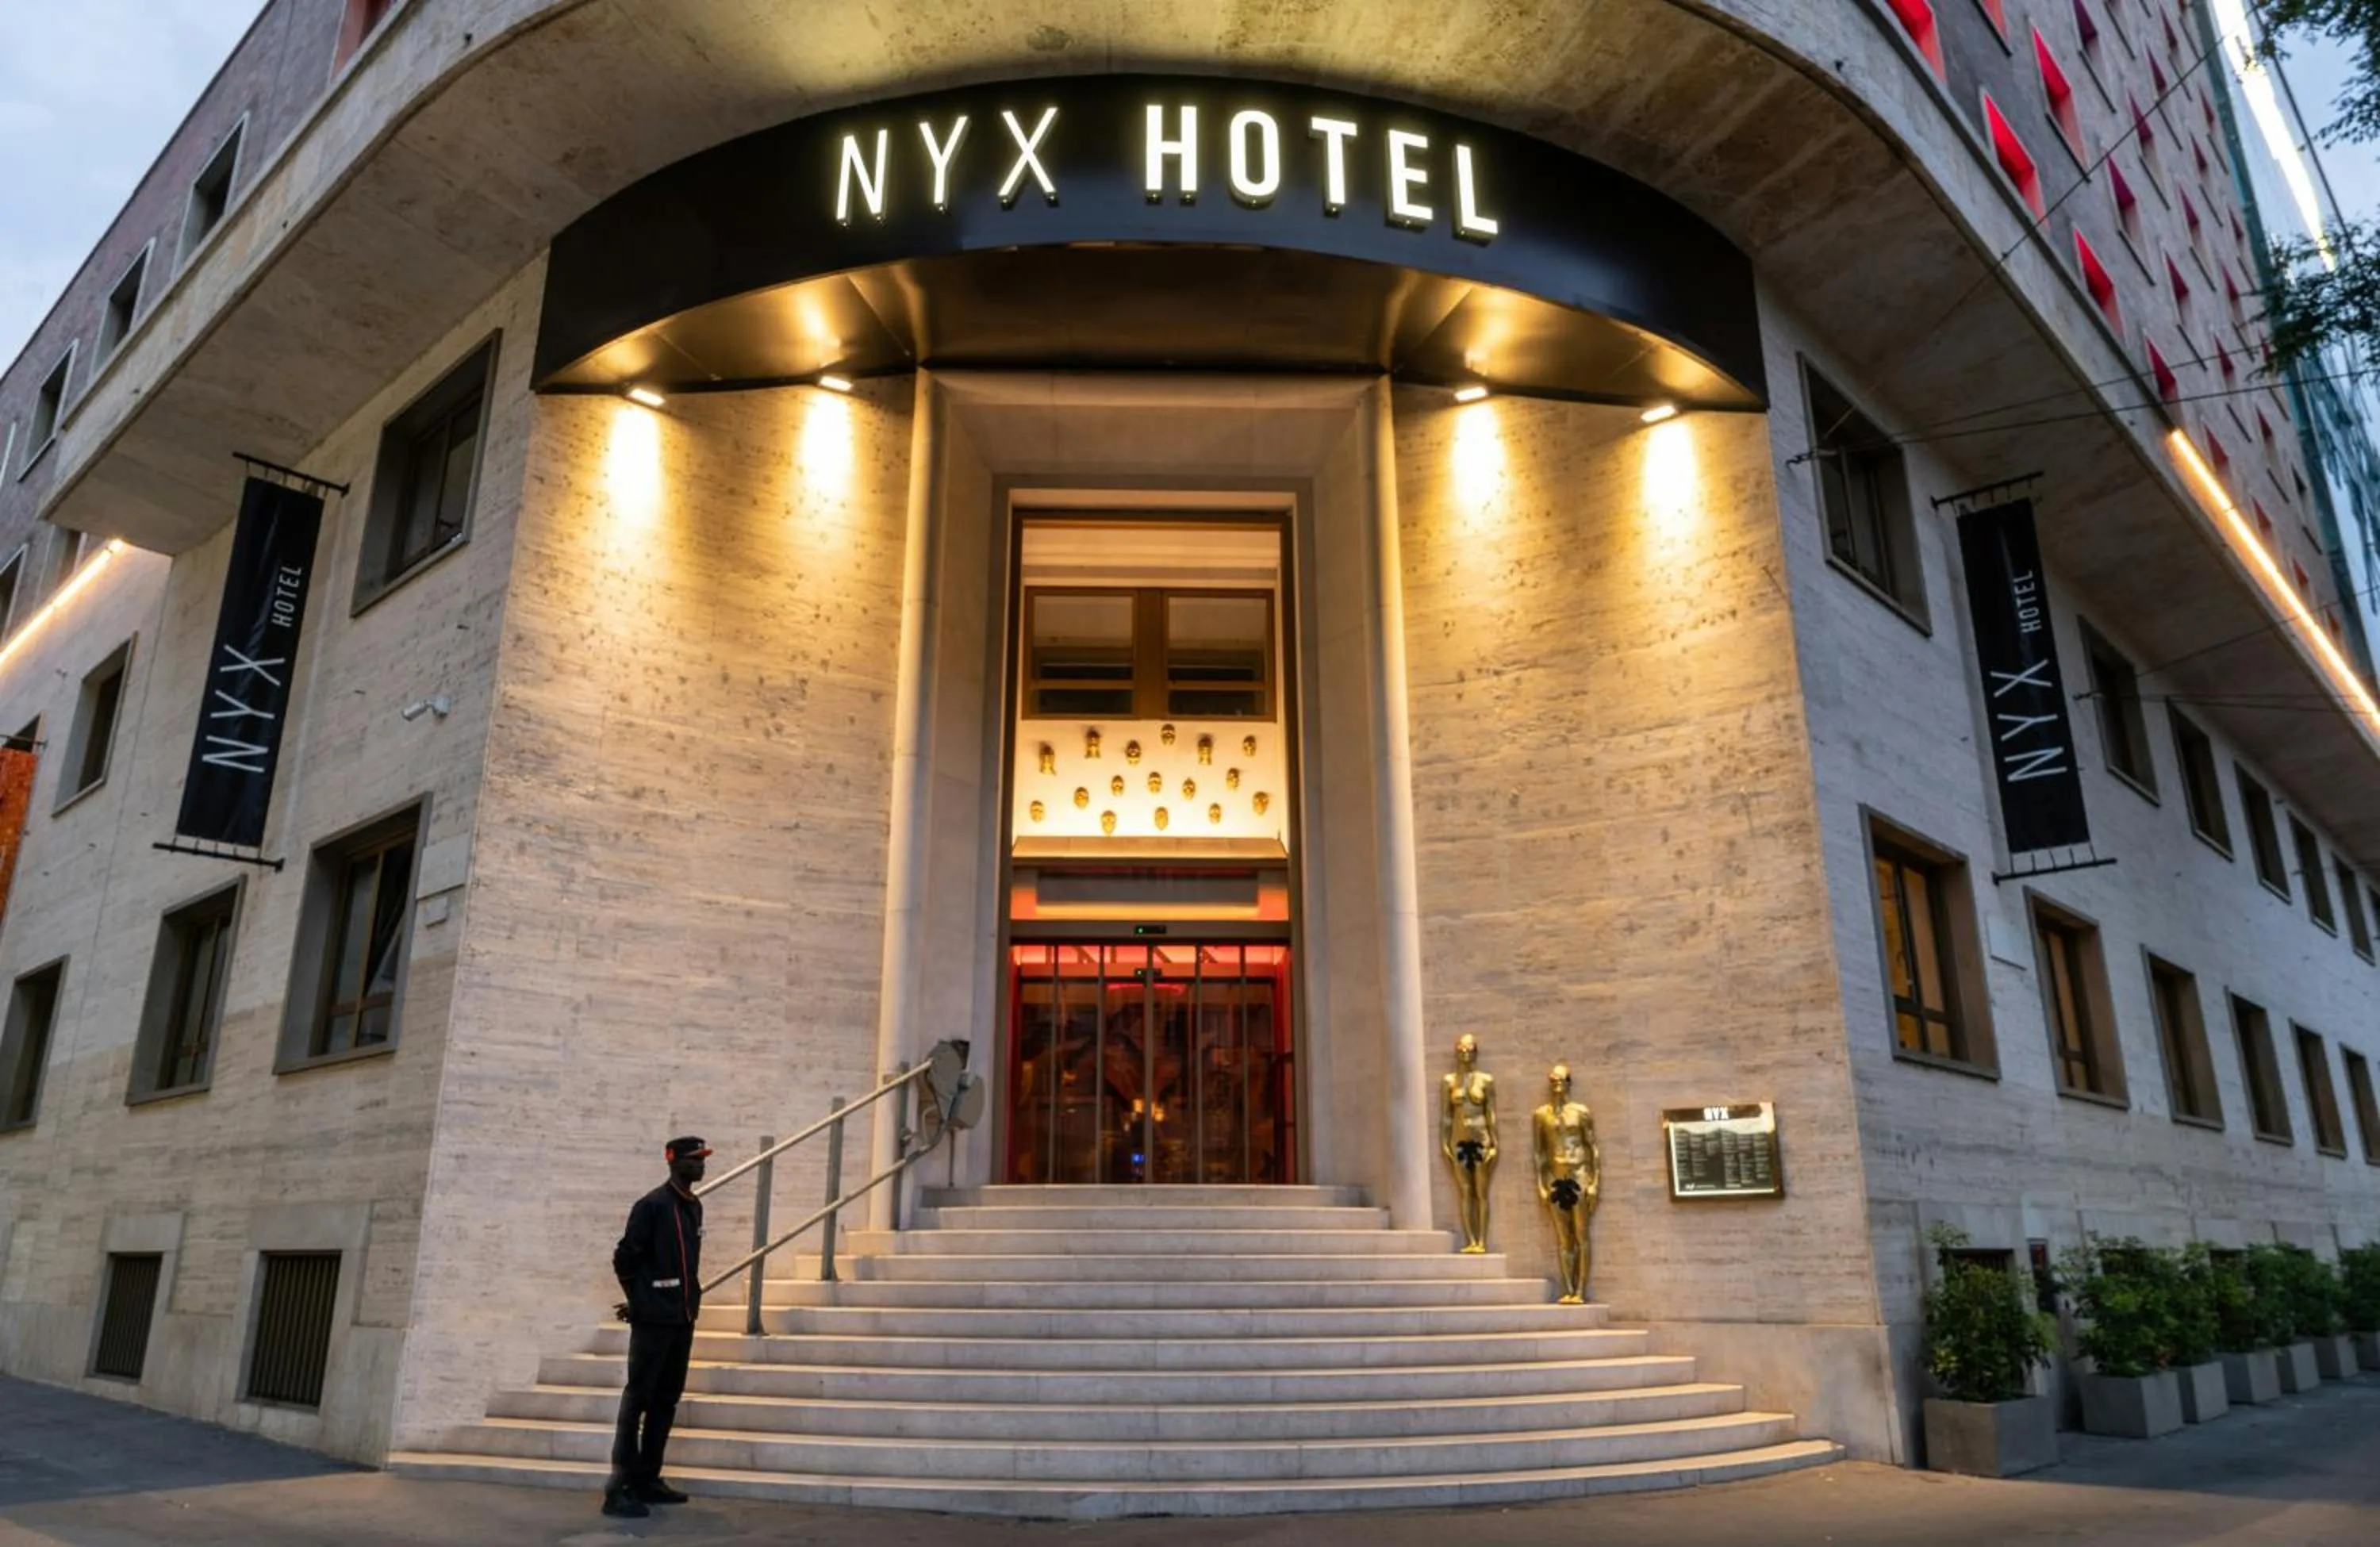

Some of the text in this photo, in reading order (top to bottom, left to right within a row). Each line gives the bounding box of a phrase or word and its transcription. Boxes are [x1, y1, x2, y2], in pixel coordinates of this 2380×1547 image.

[837, 105, 1498, 236] NYX HOTEL
[202, 566, 302, 774] NYX HOTEL
[1990, 569, 2067, 782] NYX HOTEL
